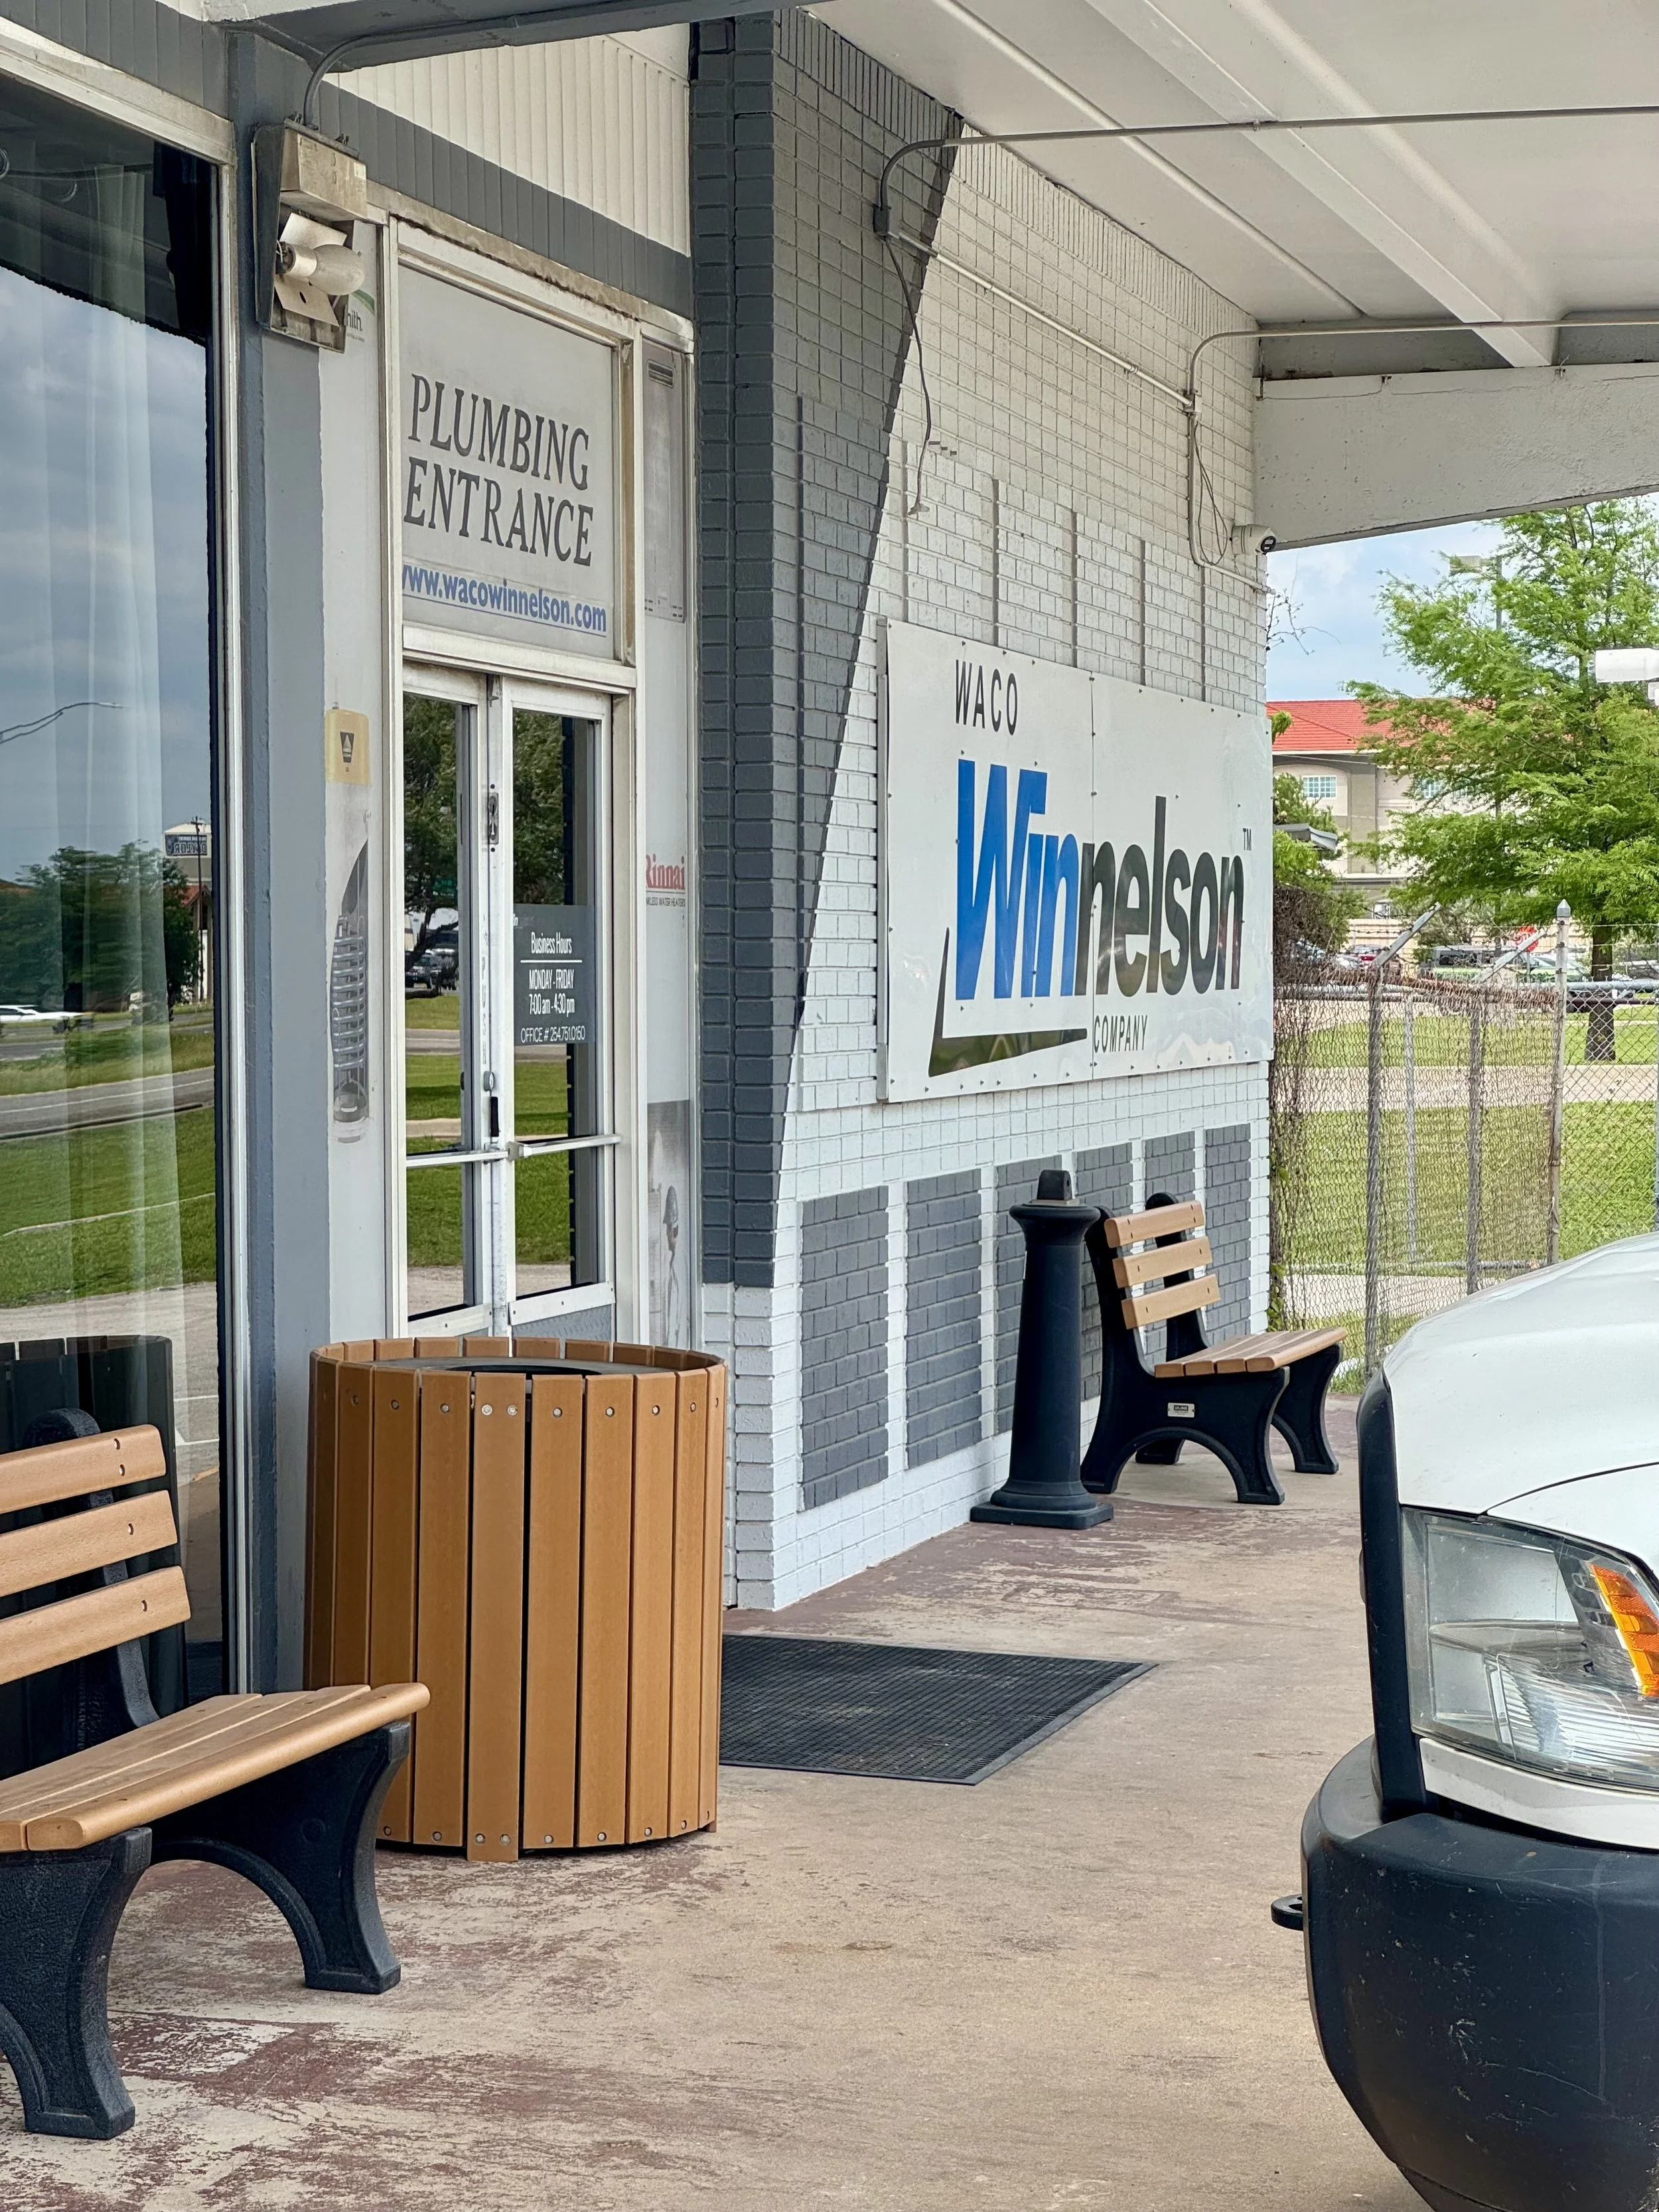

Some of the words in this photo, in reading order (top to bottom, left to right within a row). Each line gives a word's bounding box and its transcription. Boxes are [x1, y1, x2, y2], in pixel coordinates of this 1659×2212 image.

[407, 373, 589, 491] PLUMBING
[403, 456, 594, 567] ENTRANCE
[956, 659, 1018, 735] WACO
[956, 758, 1244, 1000] Winnelson
[531, 932, 555, 954] Business
[556, 932, 572, 954] Hours
[529, 968, 553, 990] MONDAY
[555, 968, 574, 989] FRIDAY
[529, 994, 541, 1015] 7:00
[542, 999, 550, 1014] am
[553, 993, 566, 1014] 4:30
[567, 998, 575, 1017] pm
[520, 1027, 543, 1043] OFFICE
[1094, 1014, 1148, 1053] COMPANY
